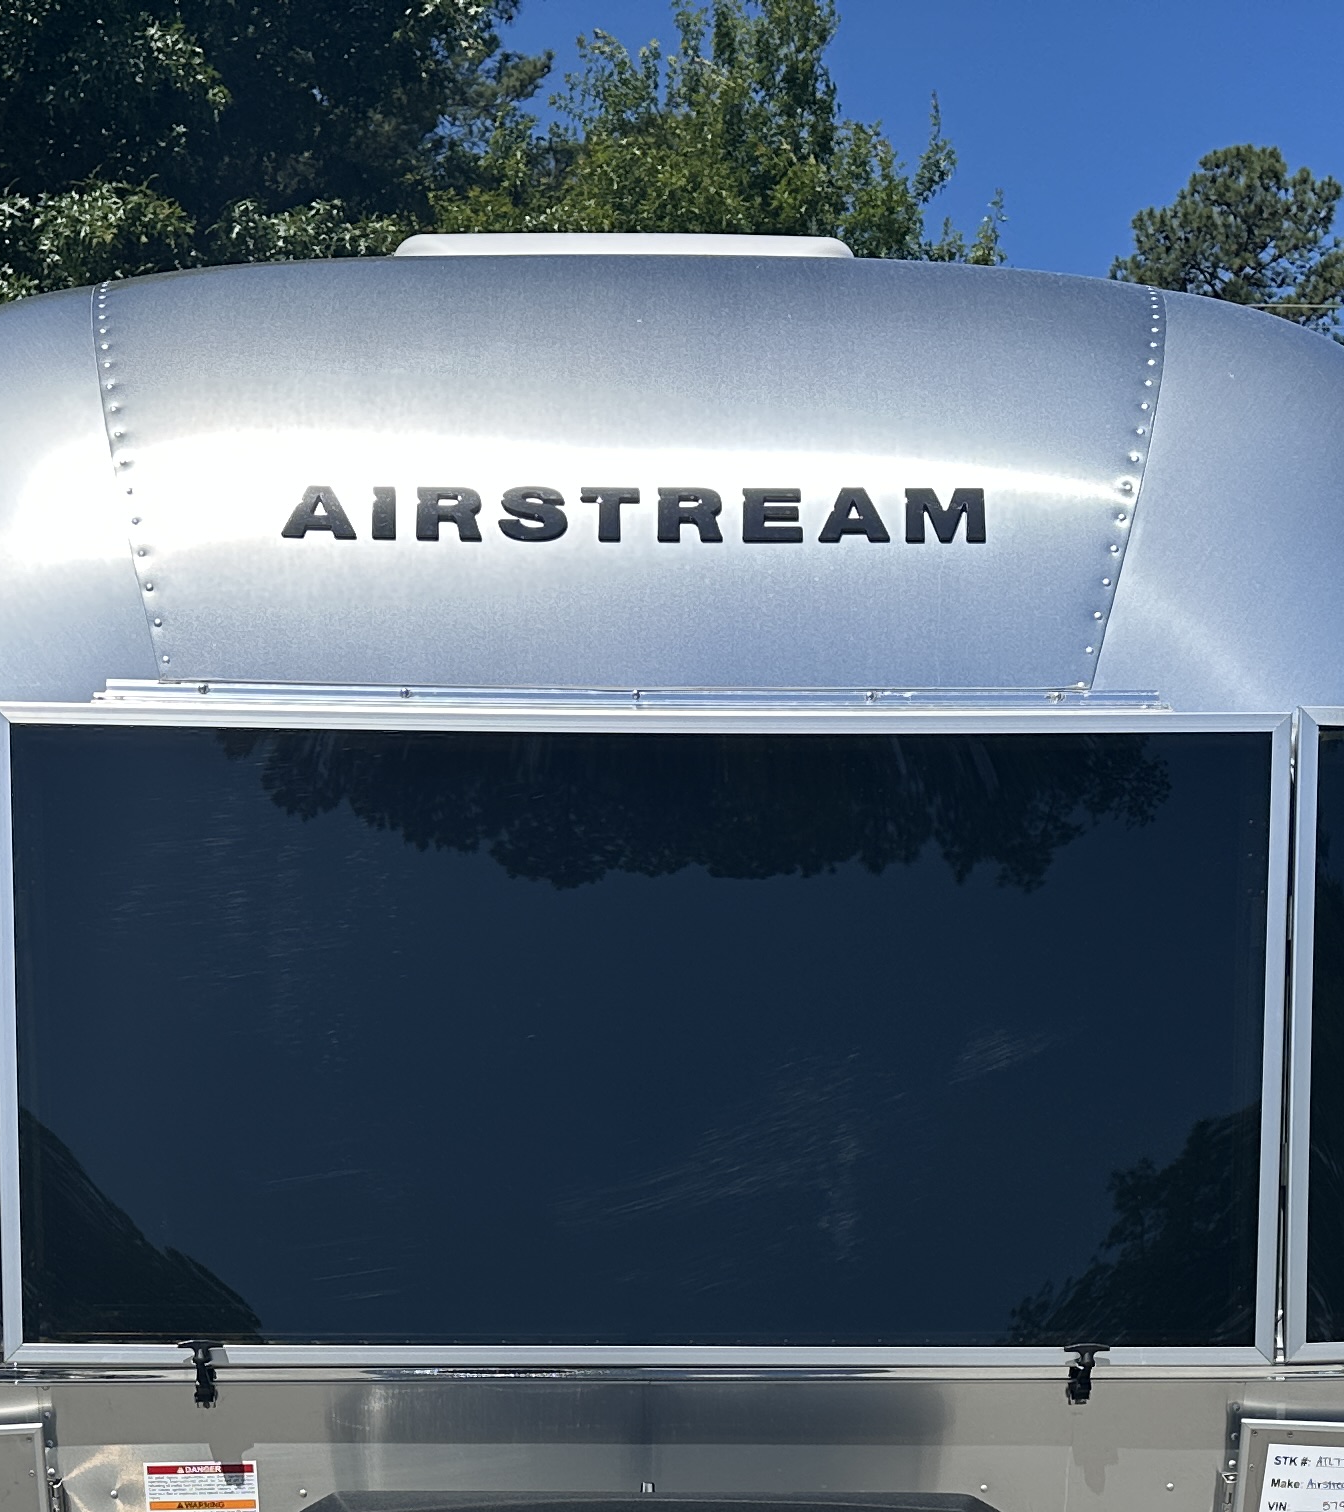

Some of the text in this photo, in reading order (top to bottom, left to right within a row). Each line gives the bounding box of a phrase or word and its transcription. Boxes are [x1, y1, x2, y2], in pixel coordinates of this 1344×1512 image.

[281, 485, 987, 544] AIRSTREAM
[1273, 1455, 1298, 1467] STK
[184, 1465, 222, 1474] DANGER
